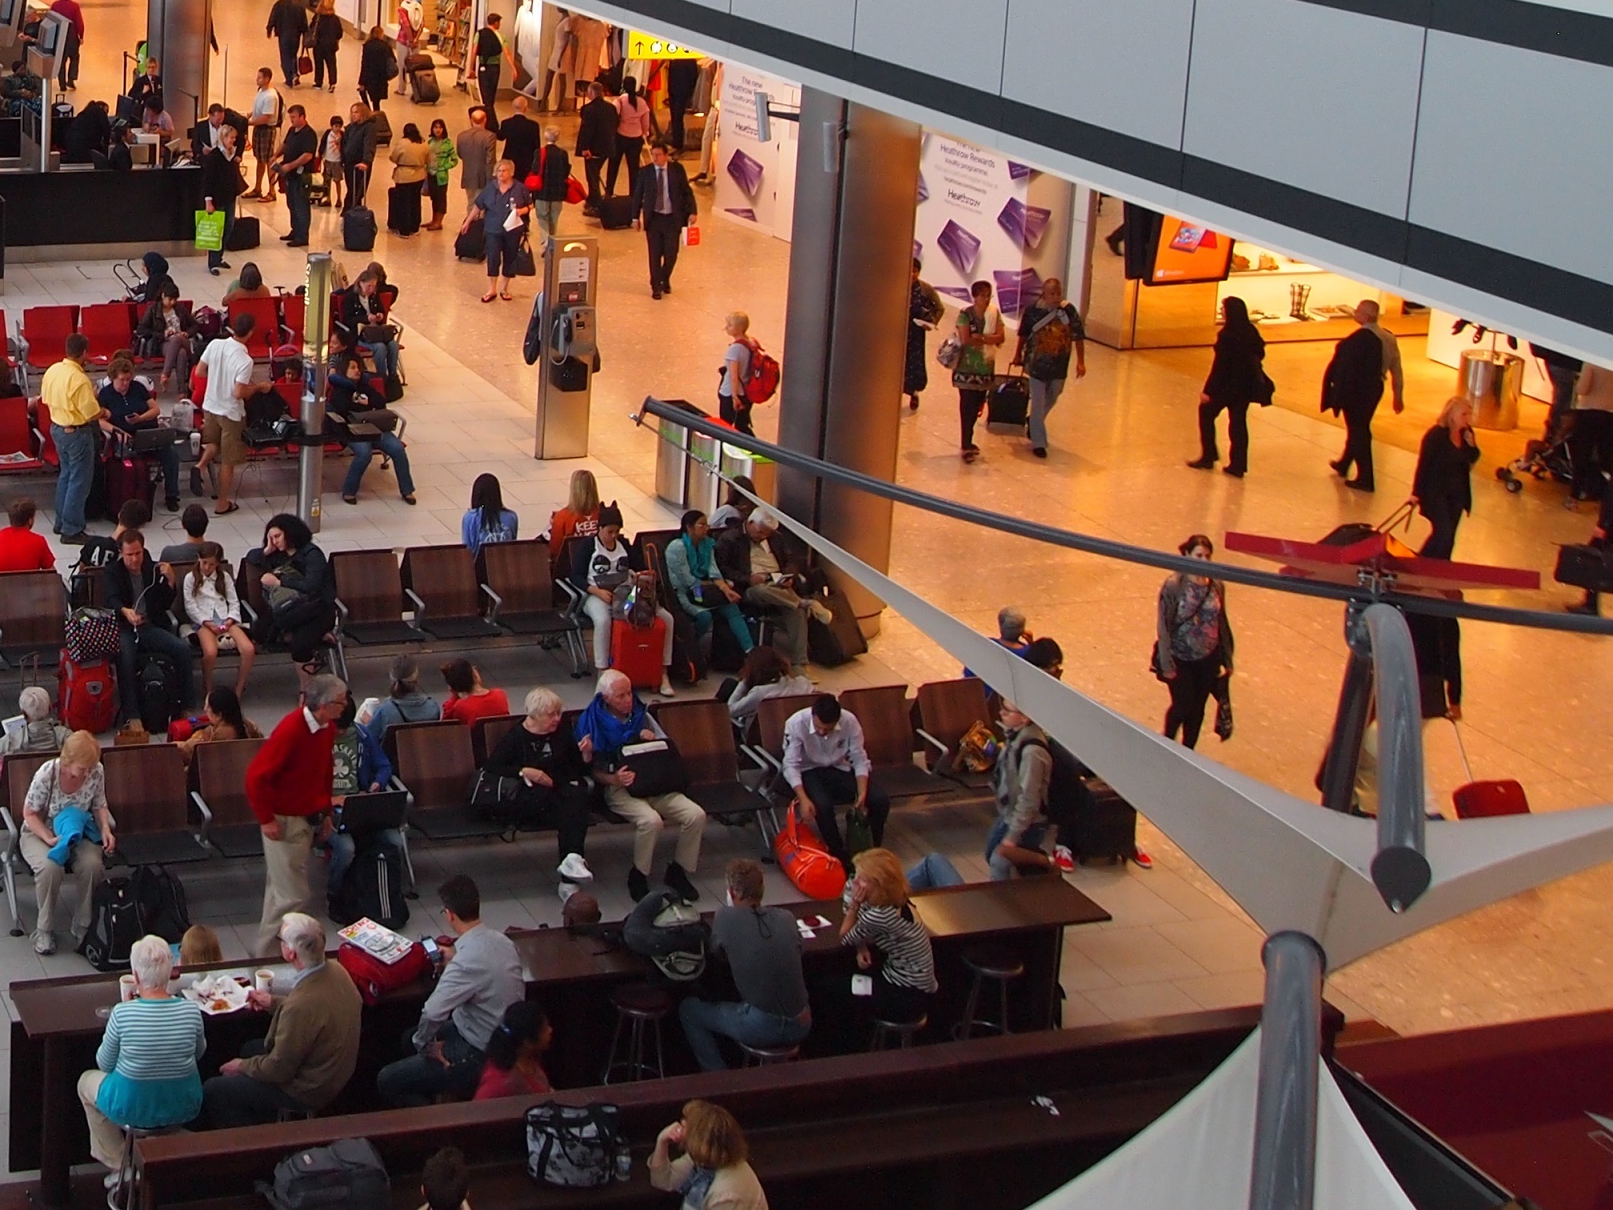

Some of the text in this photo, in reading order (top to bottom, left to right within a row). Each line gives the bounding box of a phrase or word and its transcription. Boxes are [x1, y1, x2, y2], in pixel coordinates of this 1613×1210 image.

[940, 144, 996, 169] Heathrow Rewards
[947, 188, 981, 207] Heathrow
[575, 519, 599, 533] KEE
